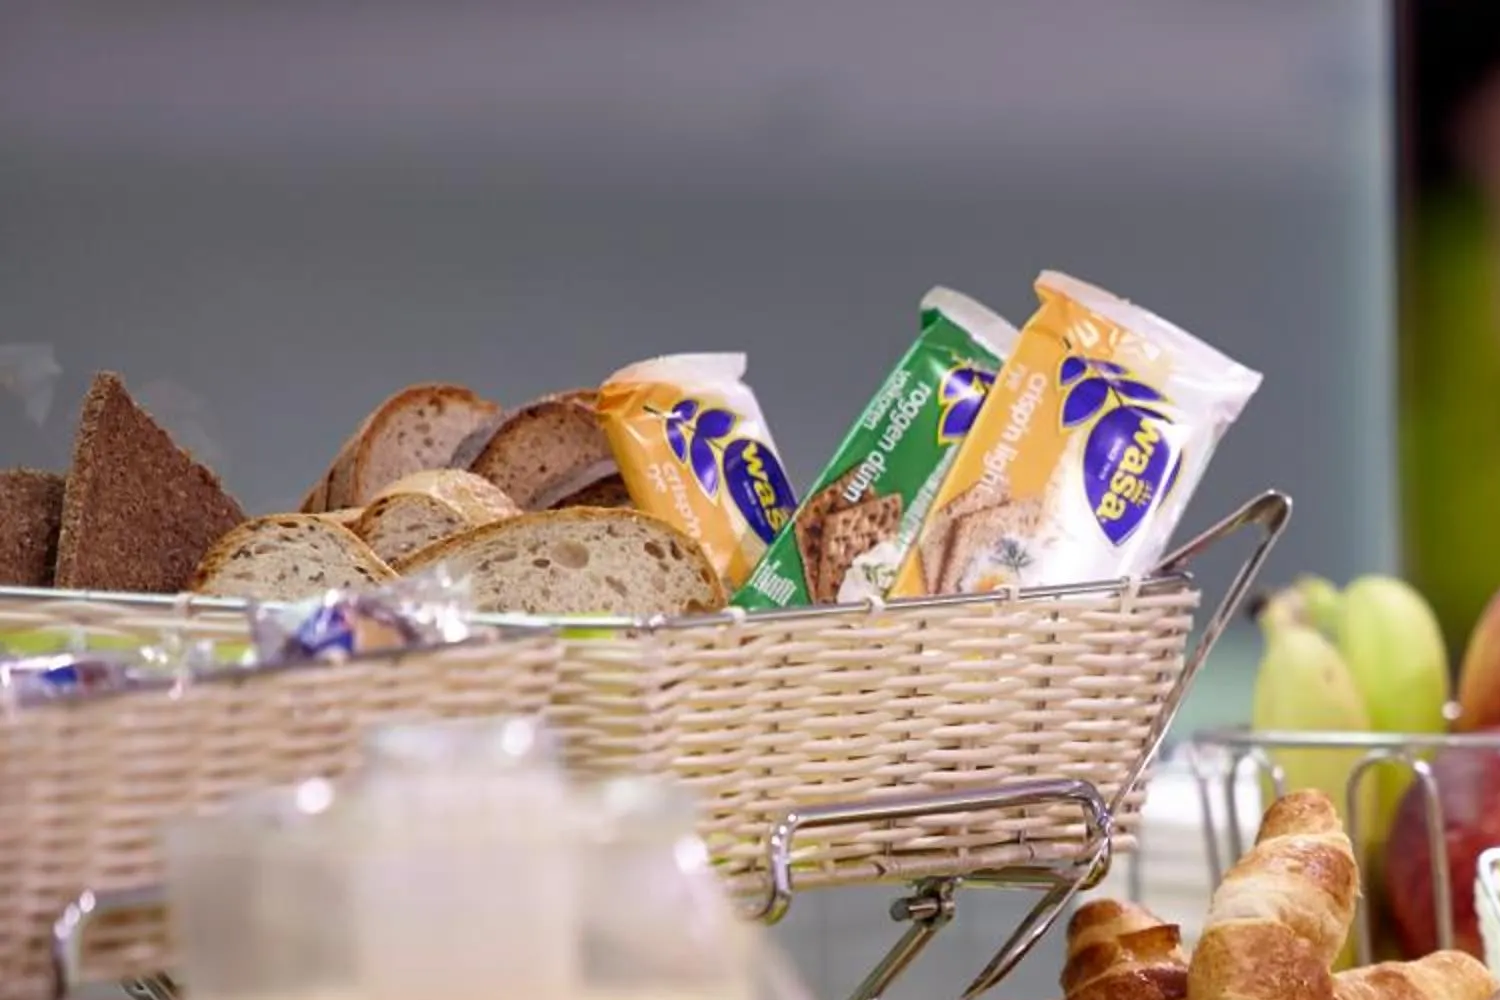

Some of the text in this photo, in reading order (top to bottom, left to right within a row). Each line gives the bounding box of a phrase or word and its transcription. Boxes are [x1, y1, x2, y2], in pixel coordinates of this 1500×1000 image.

[877, 381, 932, 451] roggen
[741, 441, 790, 534] was
[843, 451, 887, 503] dünn
[981, 445, 1019, 494] light
[1097, 418, 1160, 521] wasa
